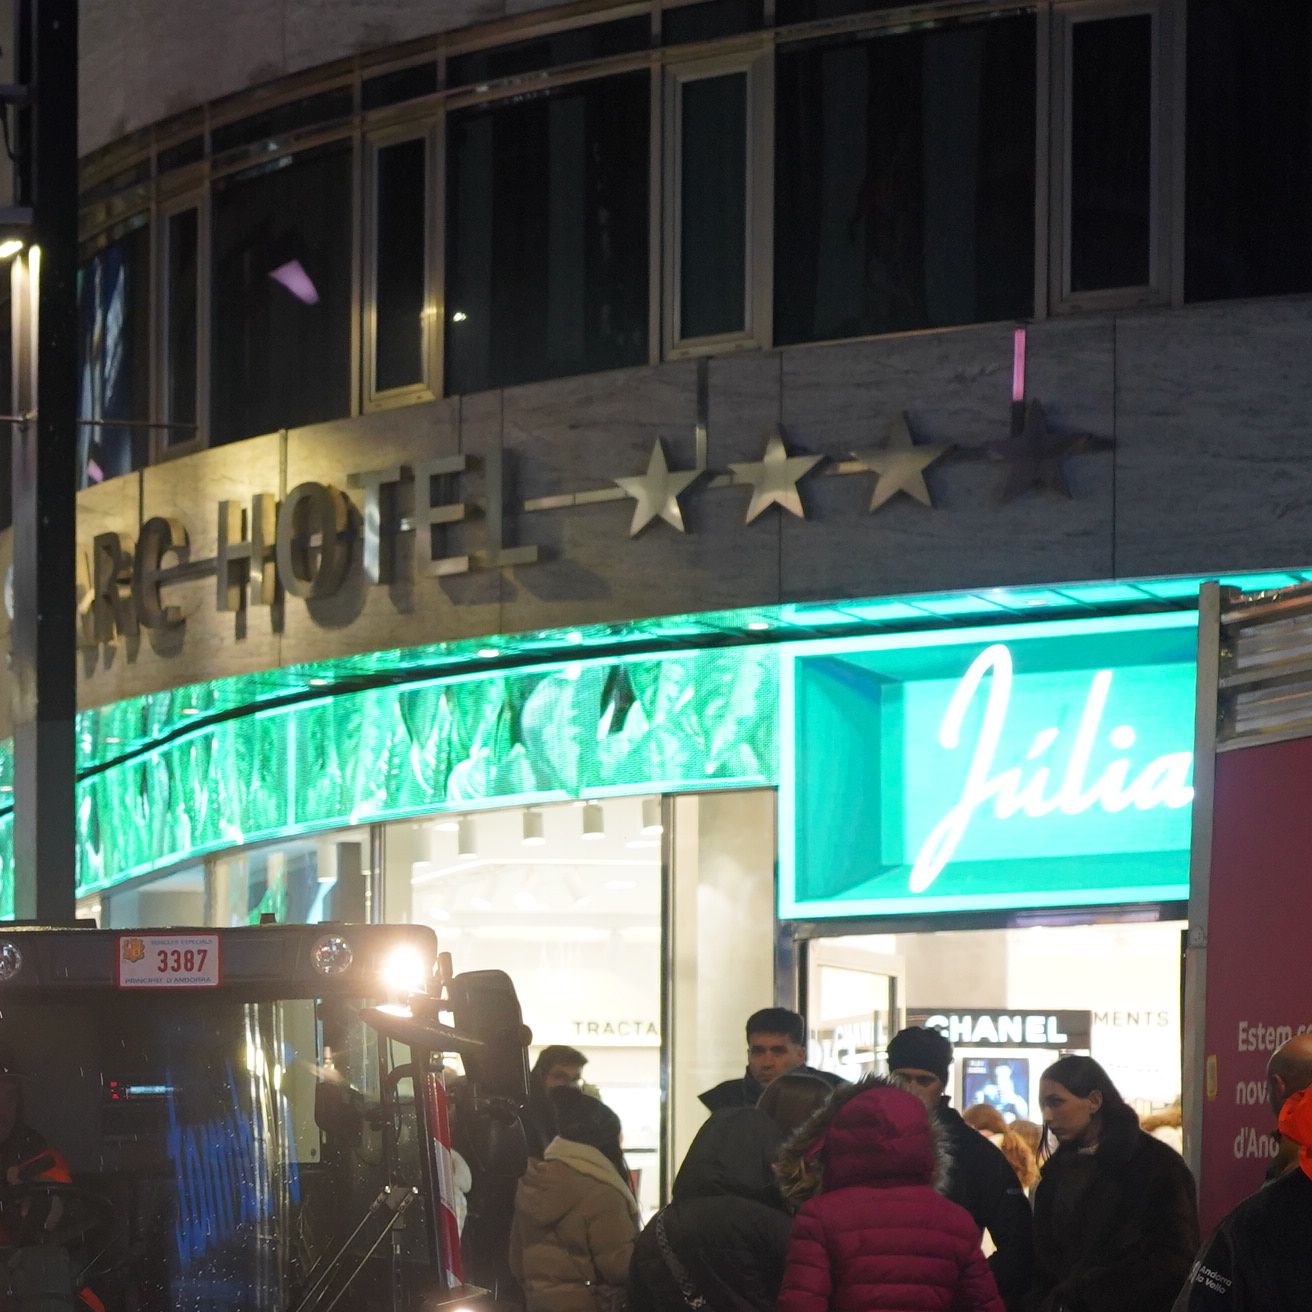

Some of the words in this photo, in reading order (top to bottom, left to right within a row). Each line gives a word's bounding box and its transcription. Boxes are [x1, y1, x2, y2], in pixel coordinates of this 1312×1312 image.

[216, 441, 539, 612] HOTEL
[909, 643, 1195, 894] Júlia
[157, 949, 209, 973] 3387
[573, 1020, 658, 1036] TRACTA
[925, 1014, 1068, 1044] CHANEL
[1094, 1010, 1170, 1028] MENTS
